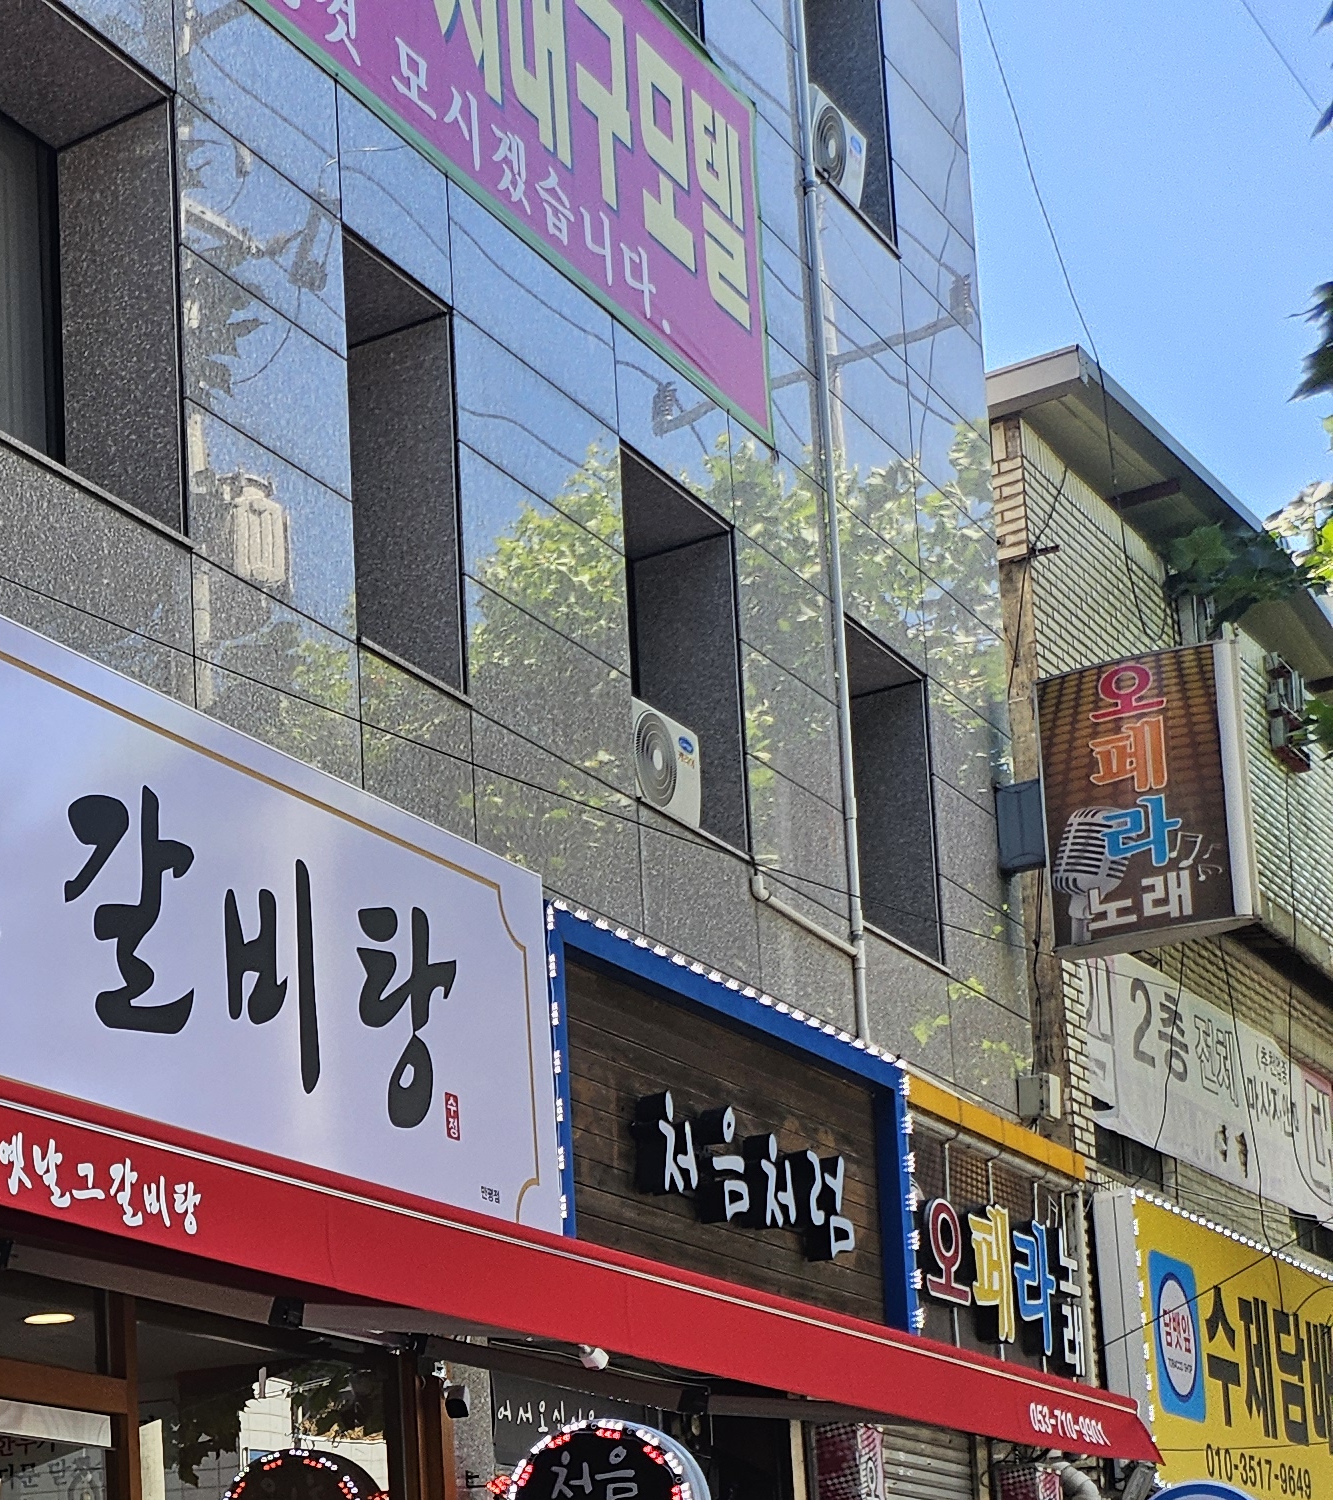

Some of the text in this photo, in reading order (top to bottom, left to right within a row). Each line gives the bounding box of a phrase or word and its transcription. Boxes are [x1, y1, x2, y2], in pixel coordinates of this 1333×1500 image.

[390, 36, 673, 335] 모시겠습니다.
[1088, 663, 1182, 867] 오페라
[63, 784, 458, 1129] 갈비탕
[1087, 870, 1193, 932] 노래
[1130, 977, 1189, 1083] 2층
[446, 1095, 459, 1138] 수정
[658, 1090, 855, 1255] 처음처럼
[926, 1198, 1086, 1377] 오페라 노래
[1029, 1401, 1112, 1447] 053-710-9901
[1205, 1443, 1312, 1500] 010-3517-9649
